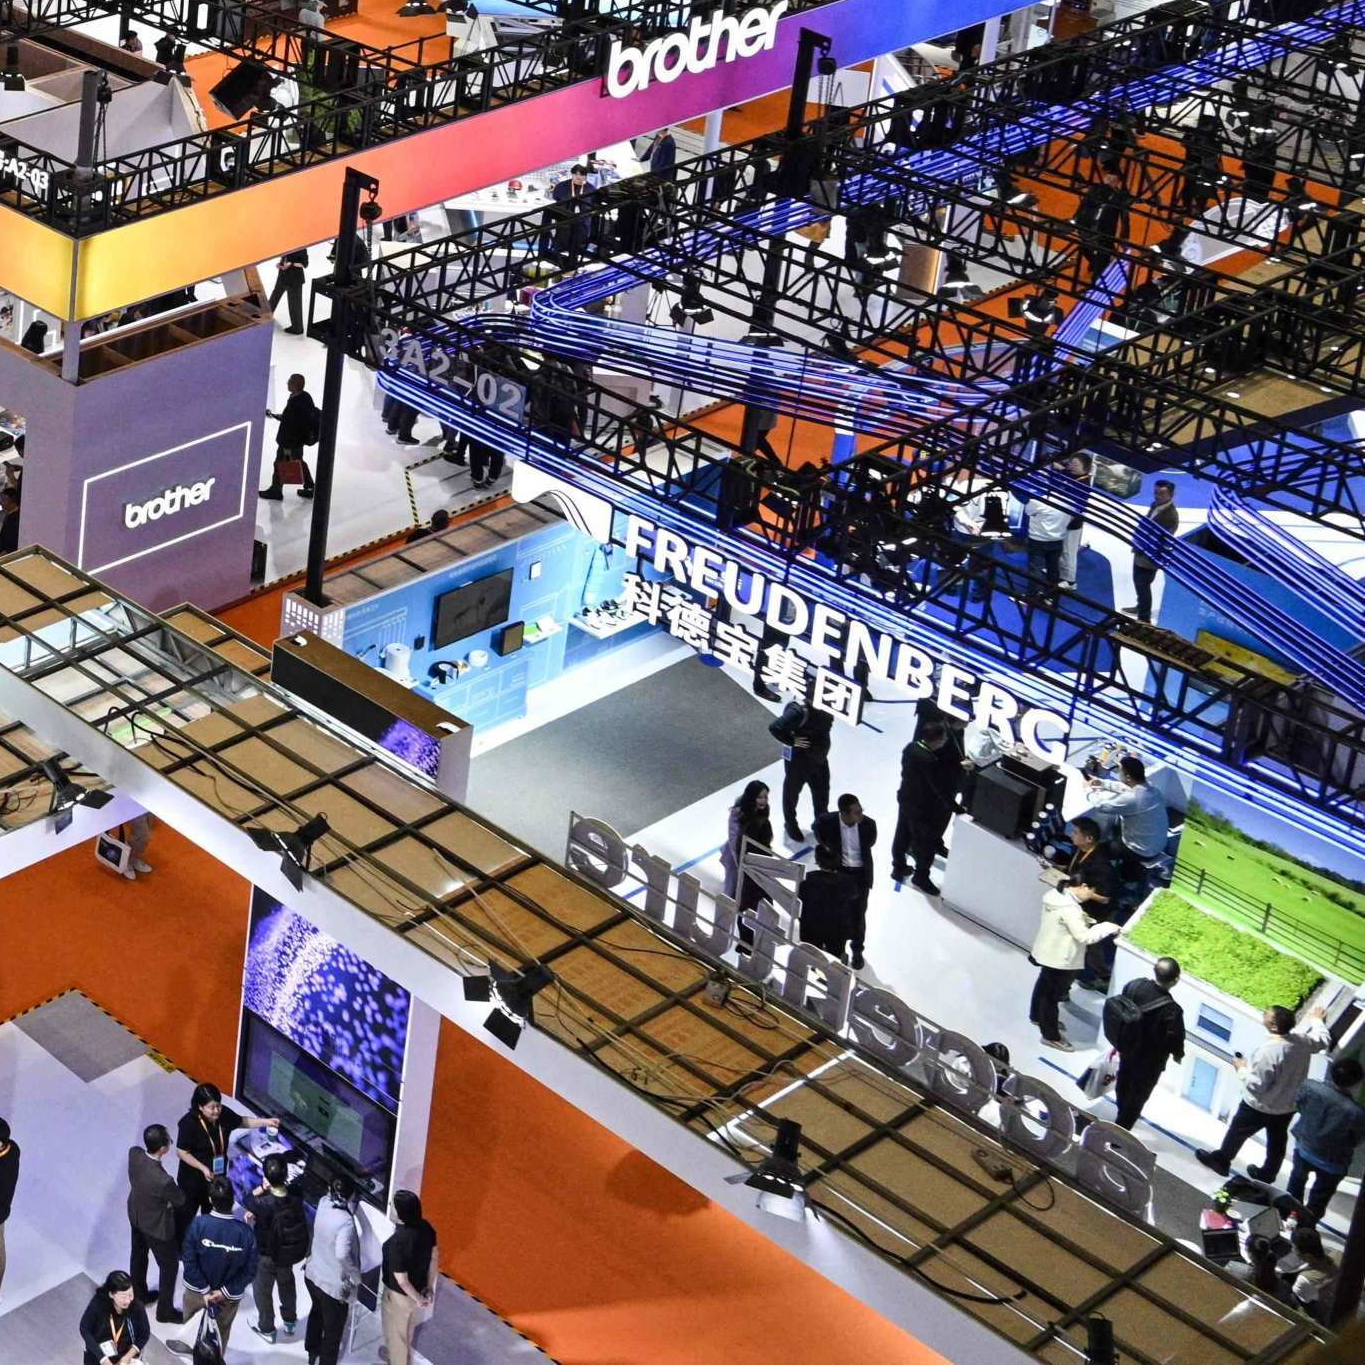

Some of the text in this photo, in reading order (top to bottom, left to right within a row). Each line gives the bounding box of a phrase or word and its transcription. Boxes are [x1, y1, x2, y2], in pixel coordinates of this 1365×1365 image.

[124, 478, 217, 530] brother
[621, 572, 864, 726] 科德宝集团
[625, 514, 1073, 767] FREUDENBERG
